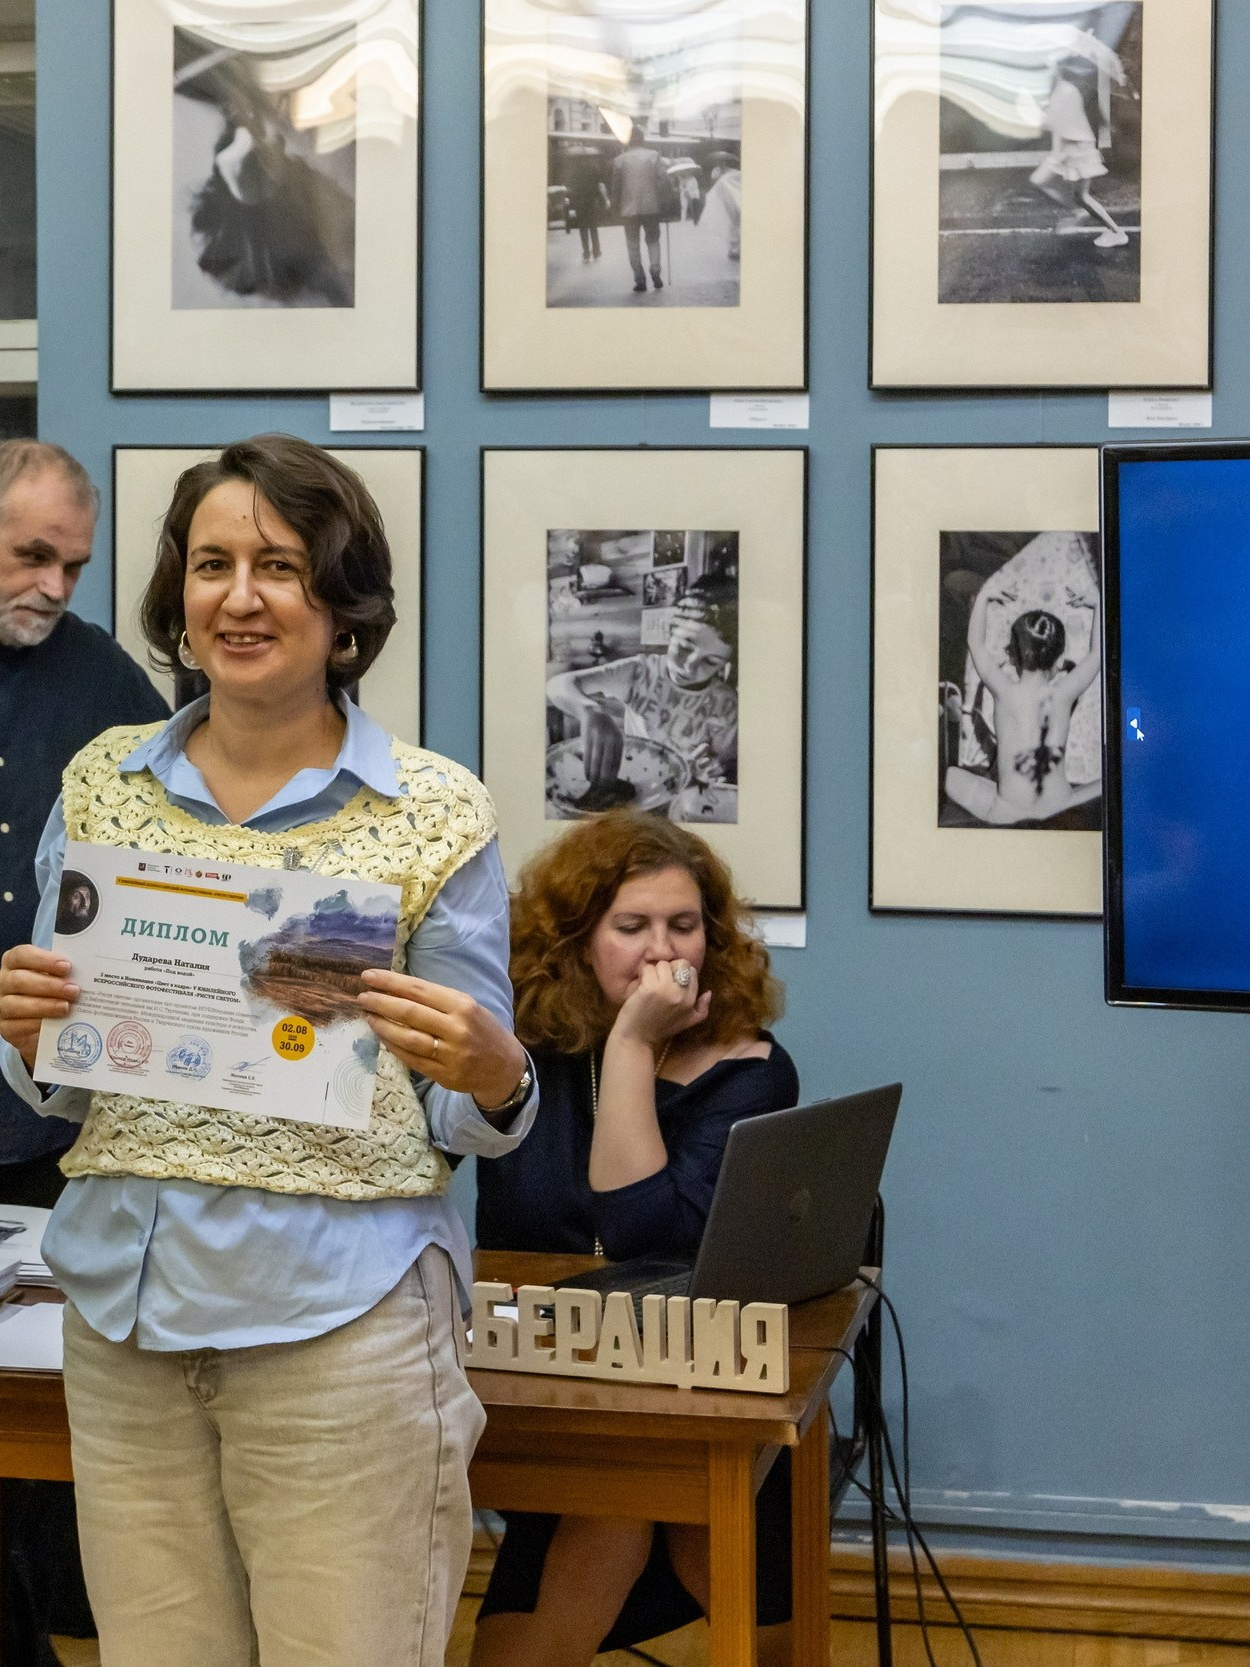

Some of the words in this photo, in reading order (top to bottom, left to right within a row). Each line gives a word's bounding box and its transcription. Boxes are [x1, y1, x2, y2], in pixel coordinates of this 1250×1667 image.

[121, 918, 230, 947] ДИПЛОМ
[131, 953, 172, 966] Дударева
[174, 959, 210, 971] Наталия
[282, 1023, 307, 1035] 02.08
[279, 1041, 305, 1053] 30.09
[464, 1281, 789, 1394] БЕРАЦИЯ
